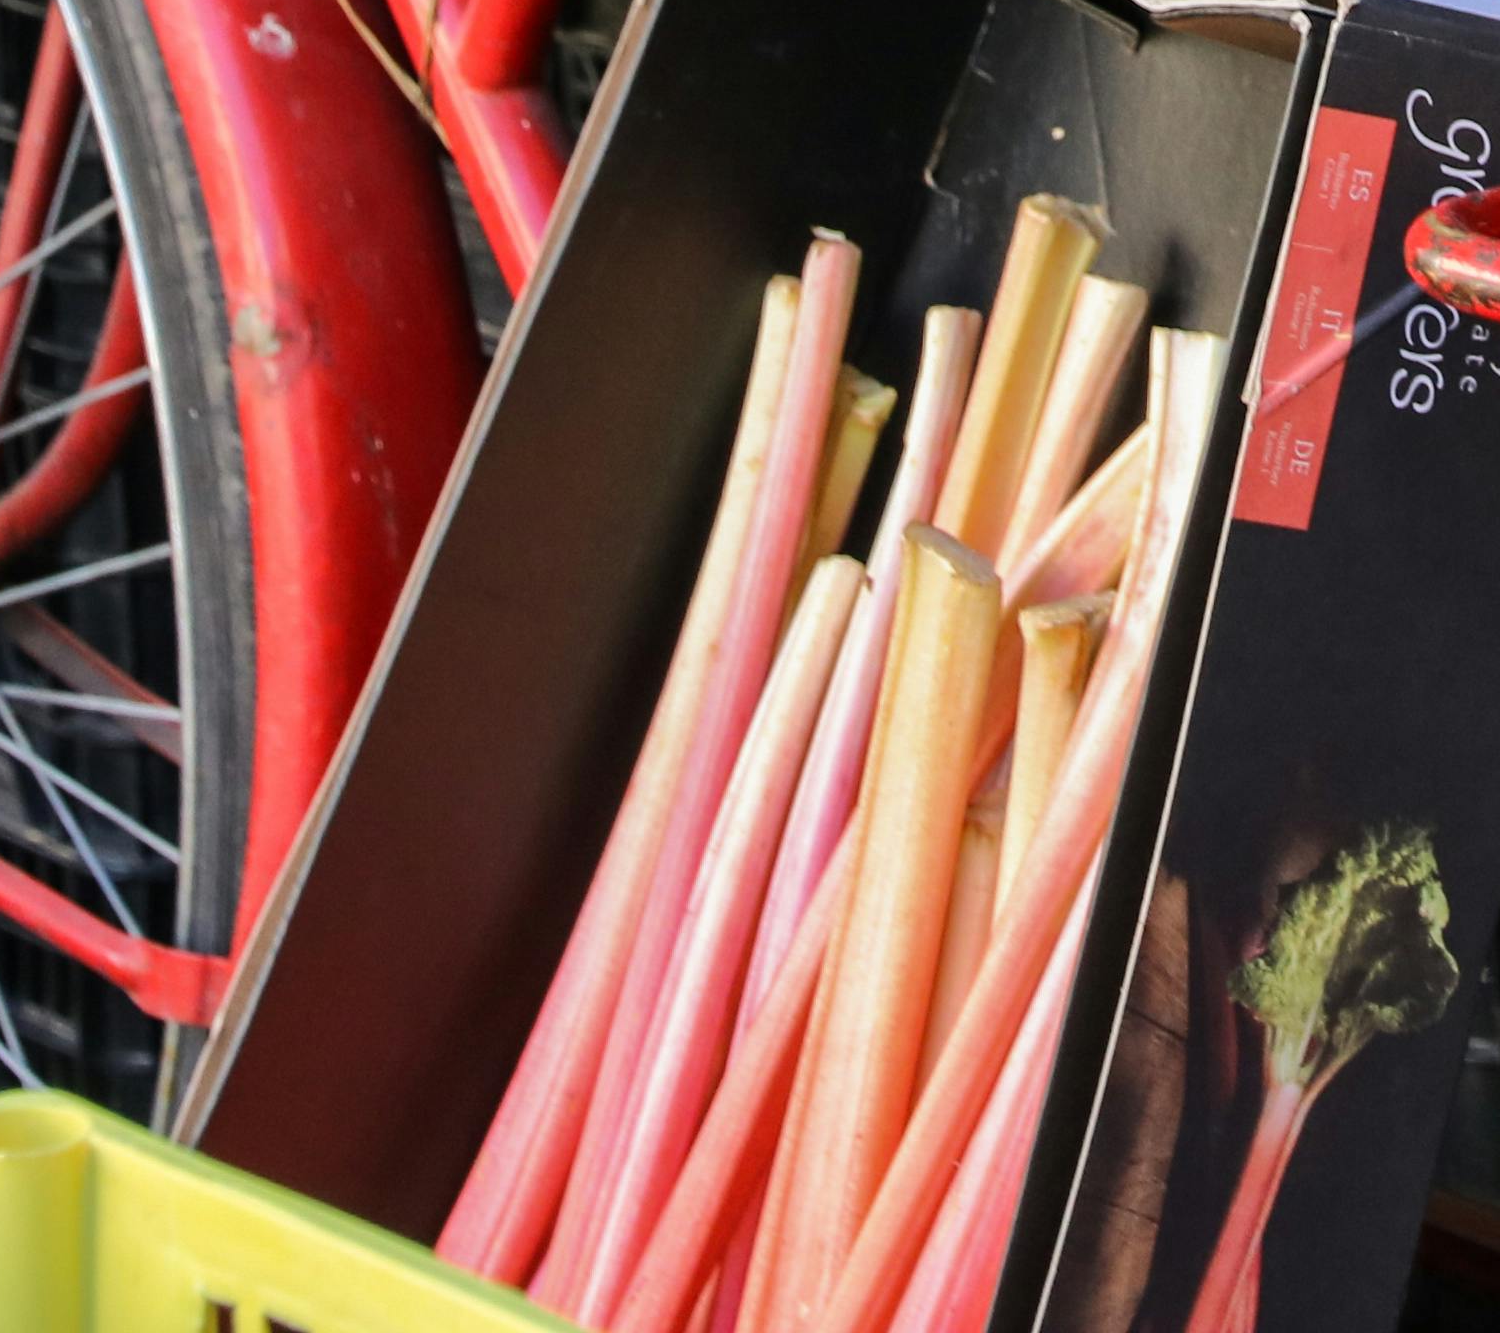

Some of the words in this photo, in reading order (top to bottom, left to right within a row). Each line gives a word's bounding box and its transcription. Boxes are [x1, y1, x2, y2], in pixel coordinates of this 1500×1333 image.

[1349, 168, 1373, 202] ES
[1389, 88, 1492, 415] grers
[1290, 439, 1315, 475] DE
